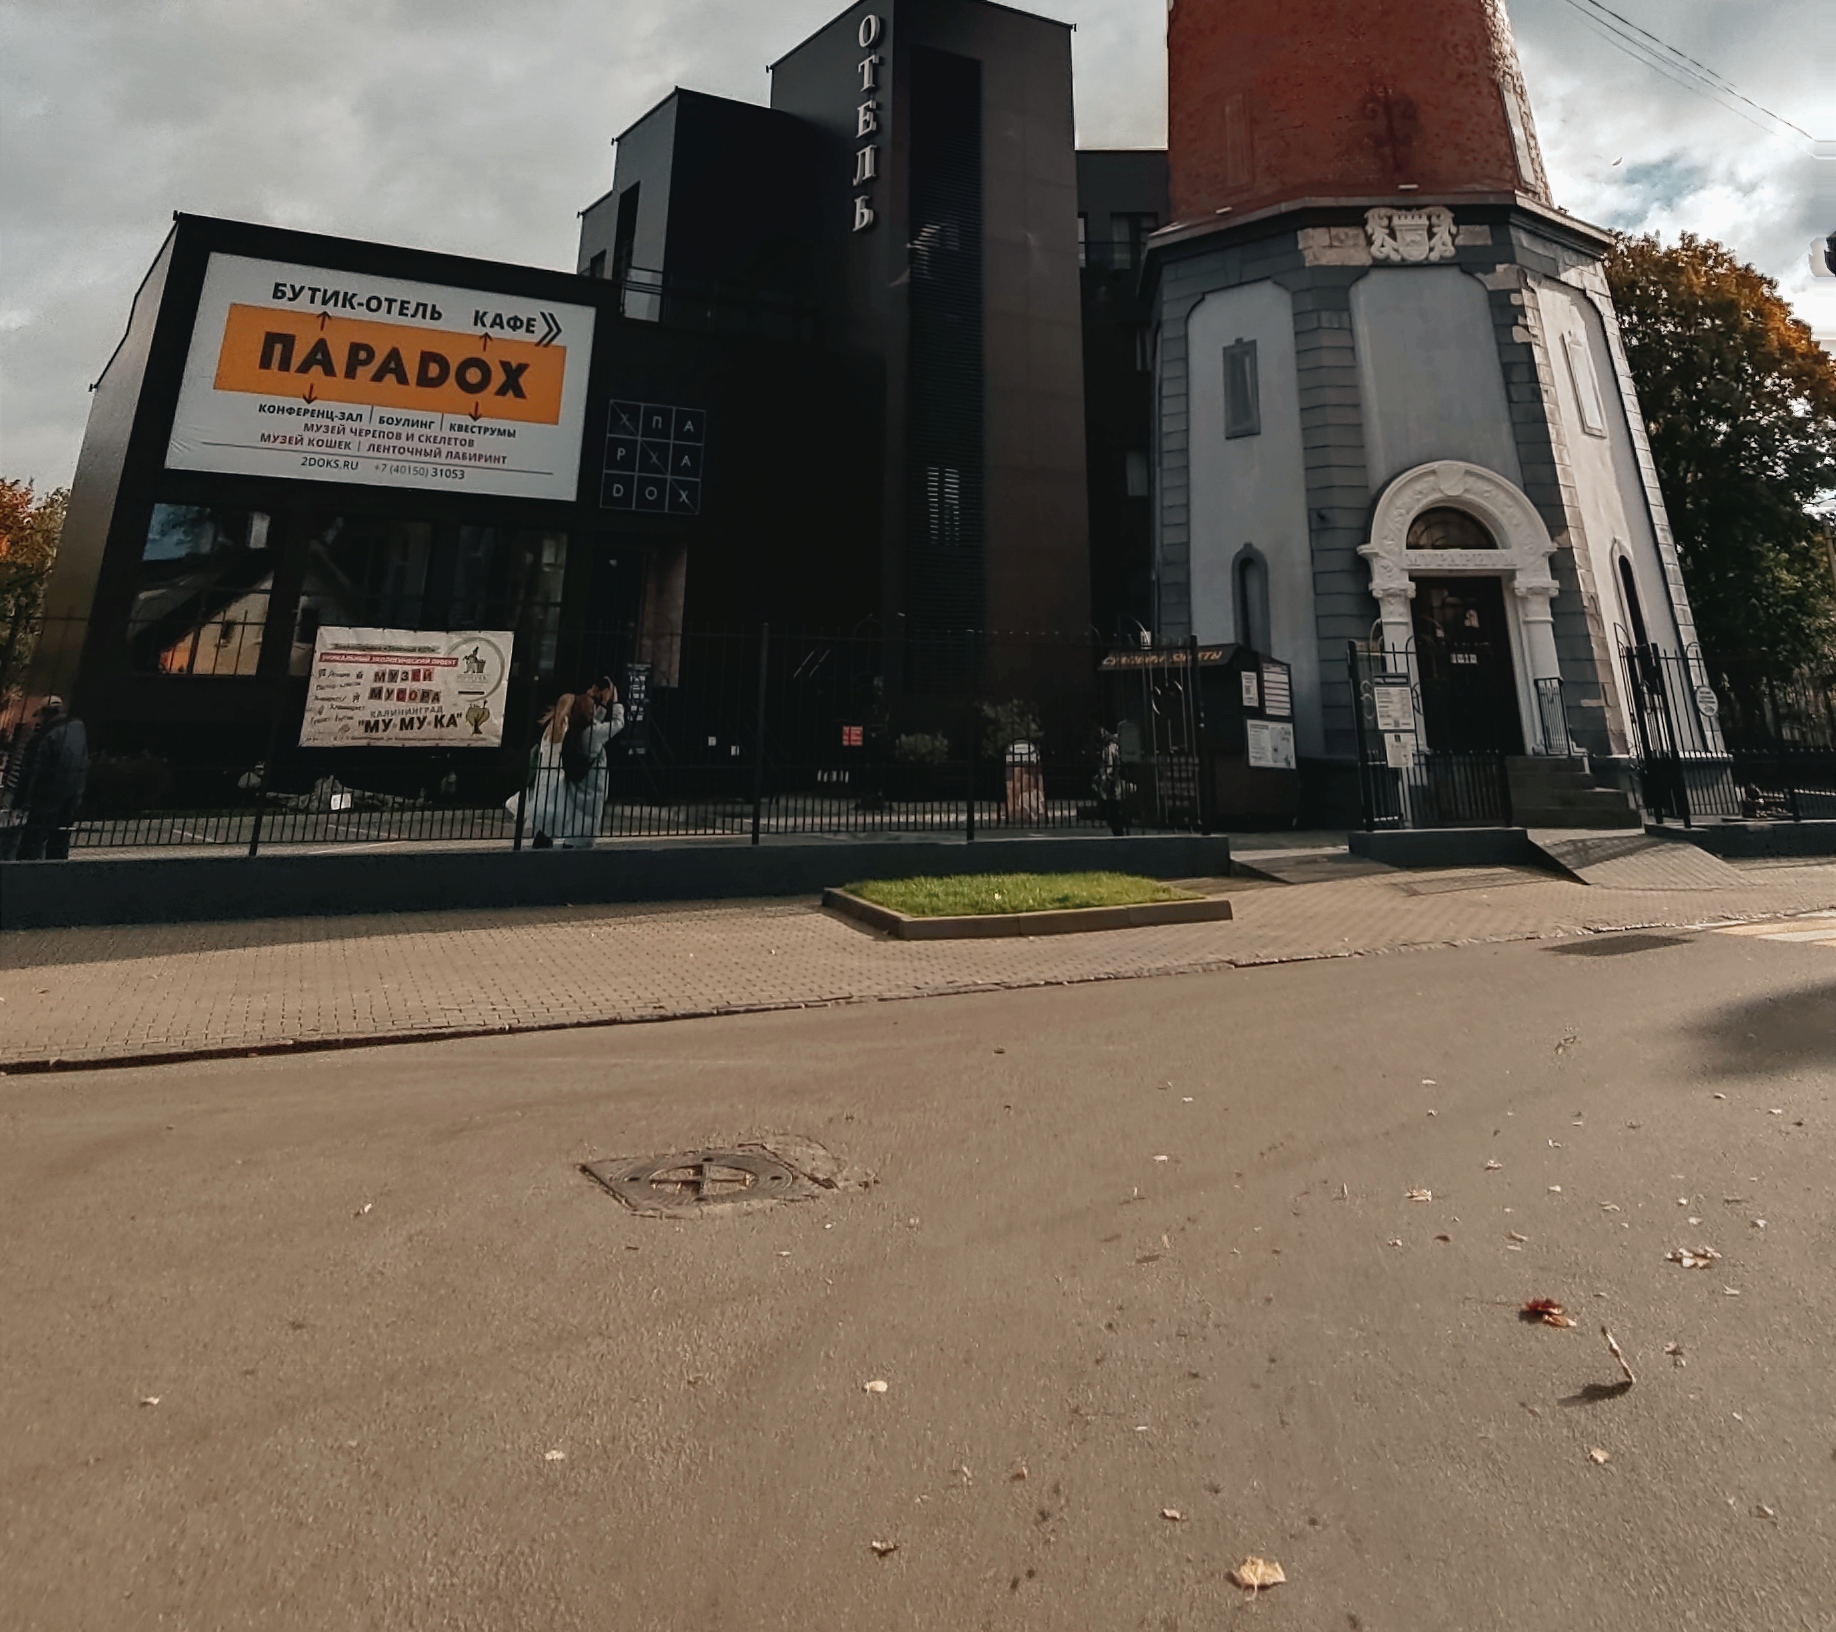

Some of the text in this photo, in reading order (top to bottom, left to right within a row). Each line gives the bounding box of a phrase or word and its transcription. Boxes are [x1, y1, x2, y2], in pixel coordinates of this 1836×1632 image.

[853, 14, 880, 232] ОТЕЛЬ
[272, 282, 537, 334] БУТИК-ОТЕЛЬ КАФЕ
[258, 404, 516, 438] КОНФЕРЕНЦ-ЗАЛ БОУЛИНГ КВЕСТРУМЫ
[303, 423, 475, 448] МУЗЕЙ ЧЕРЕПОВ И СКЕЛЕТОВ
[260, 433, 508, 464] МУЗЕЙ КОШЕК ЛЕНТОЧНЫЙ ЛАБИРИНТ
[301, 457, 359, 471] 2DOKS.RU
[390, 464, 429, 477] (40150)
[431, 467, 465, 480] 31053
[373, 669, 433, 683] МУЗЕЙ
[368, 687, 440, 703] МУСОРА
[370, 706, 443, 717] КАЛИНИНГРАД
